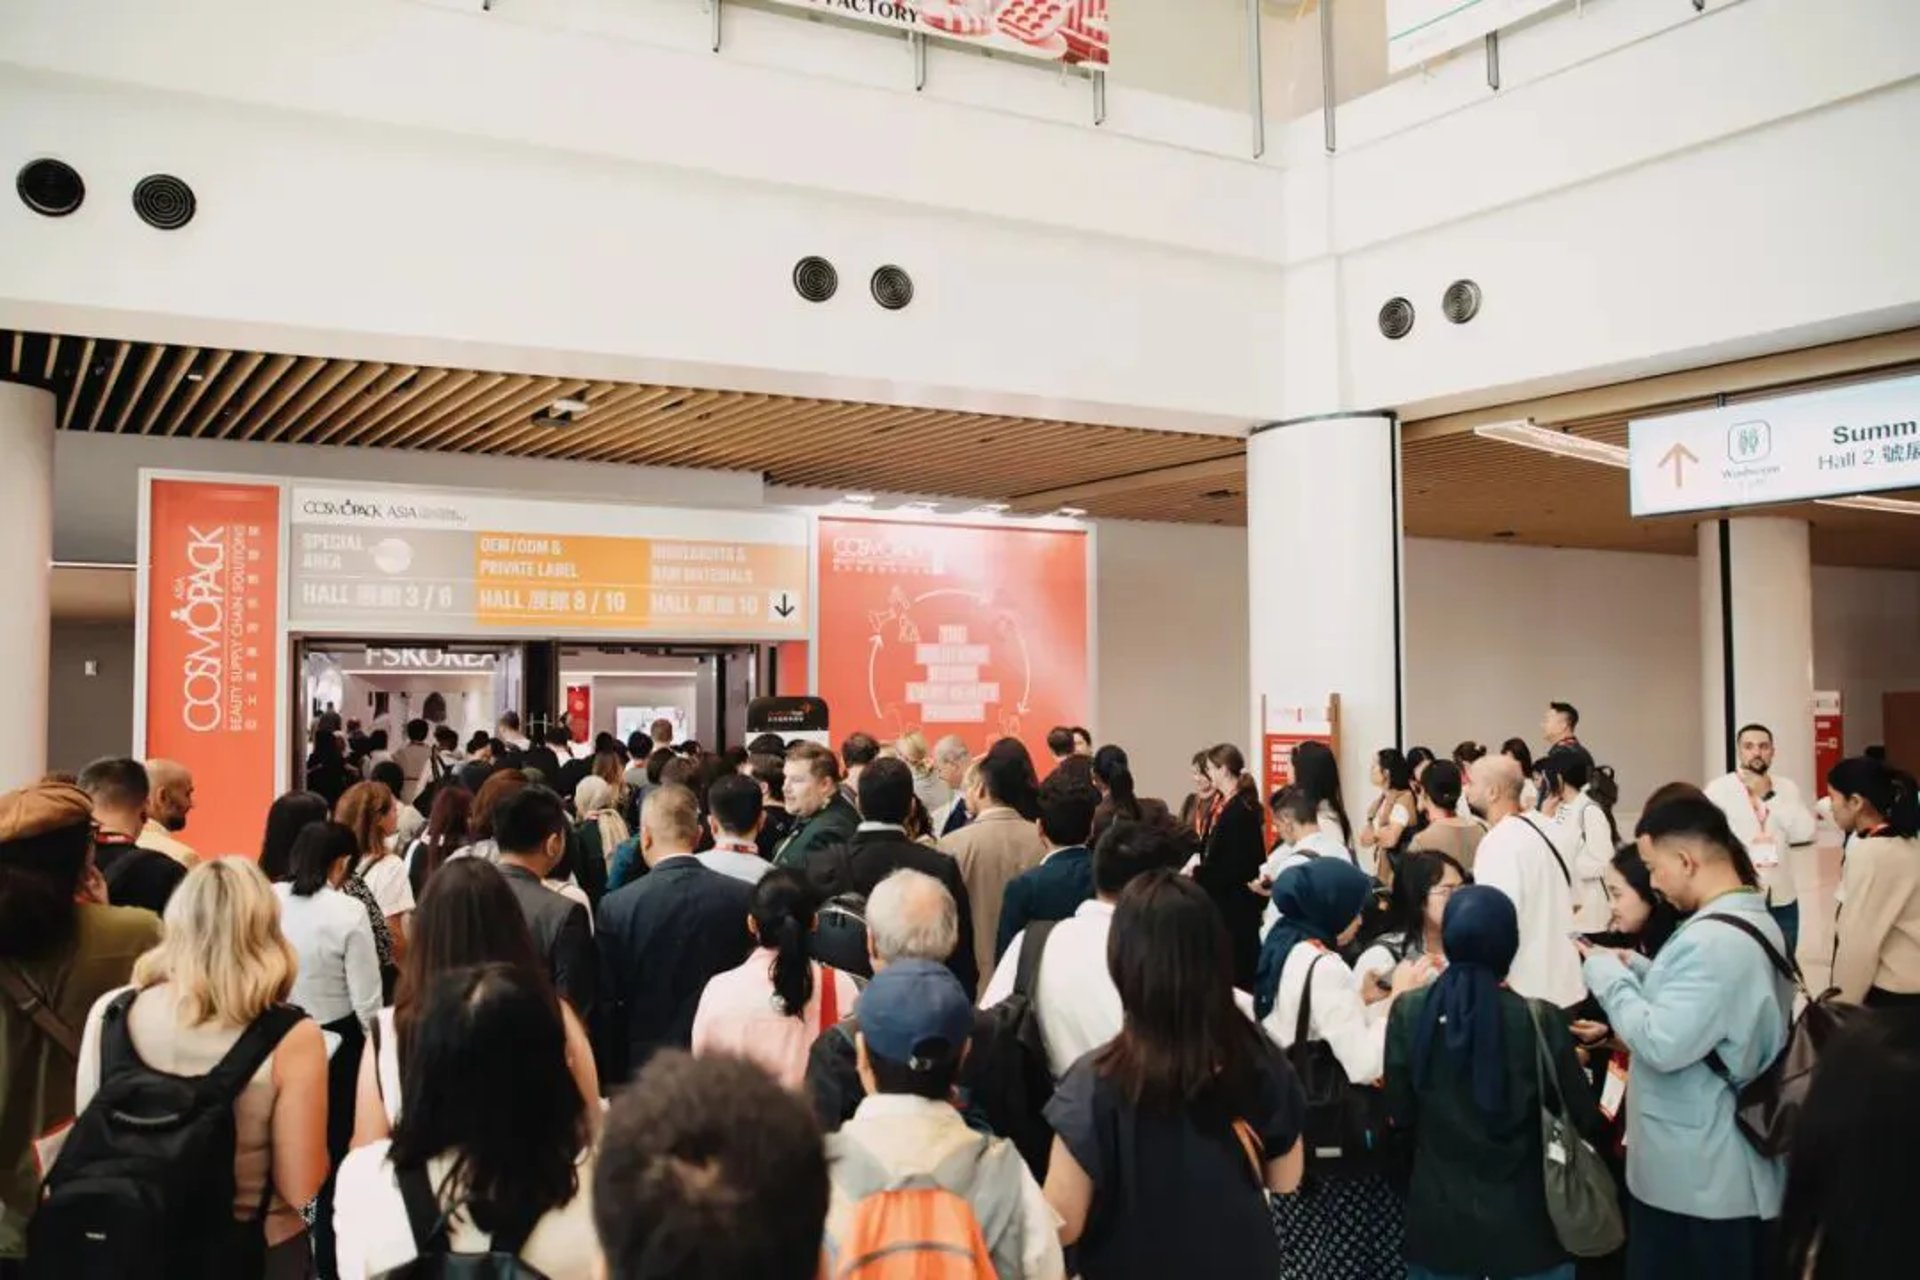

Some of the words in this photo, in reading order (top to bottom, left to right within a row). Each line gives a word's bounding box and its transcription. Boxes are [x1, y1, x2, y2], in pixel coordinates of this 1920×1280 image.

[826, 0, 918, 23] ACTORY
[1833, 421, 1917, 444] Summ
[1818, 451, 1855, 470] Hall
[1862, 448, 1875, 465] 2
[304, 498, 382, 518] COSMOPACK
[388, 505, 417, 519] ASIA
[303, 533, 364, 551] SPECIAL
[232, 526, 245, 593] SOLUTIONS
[303, 553, 341, 569] AREA
[480, 560, 533, 577] PRIVATE
[538, 562, 578, 578] LABEL
[303, 583, 348, 604] HALL
[405, 585, 419, 607] 3
[424, 585, 434, 611] /
[480, 589, 524, 608] HALL
[604, 592, 626, 613] 10
[653, 592, 690, 612] HALL
[231, 597, 244, 637] CHAIN
[183, 526, 224, 732] COSMOPACK
[231, 640, 243, 683] SUPPLY
[230, 687, 242, 731] BEAUTY
